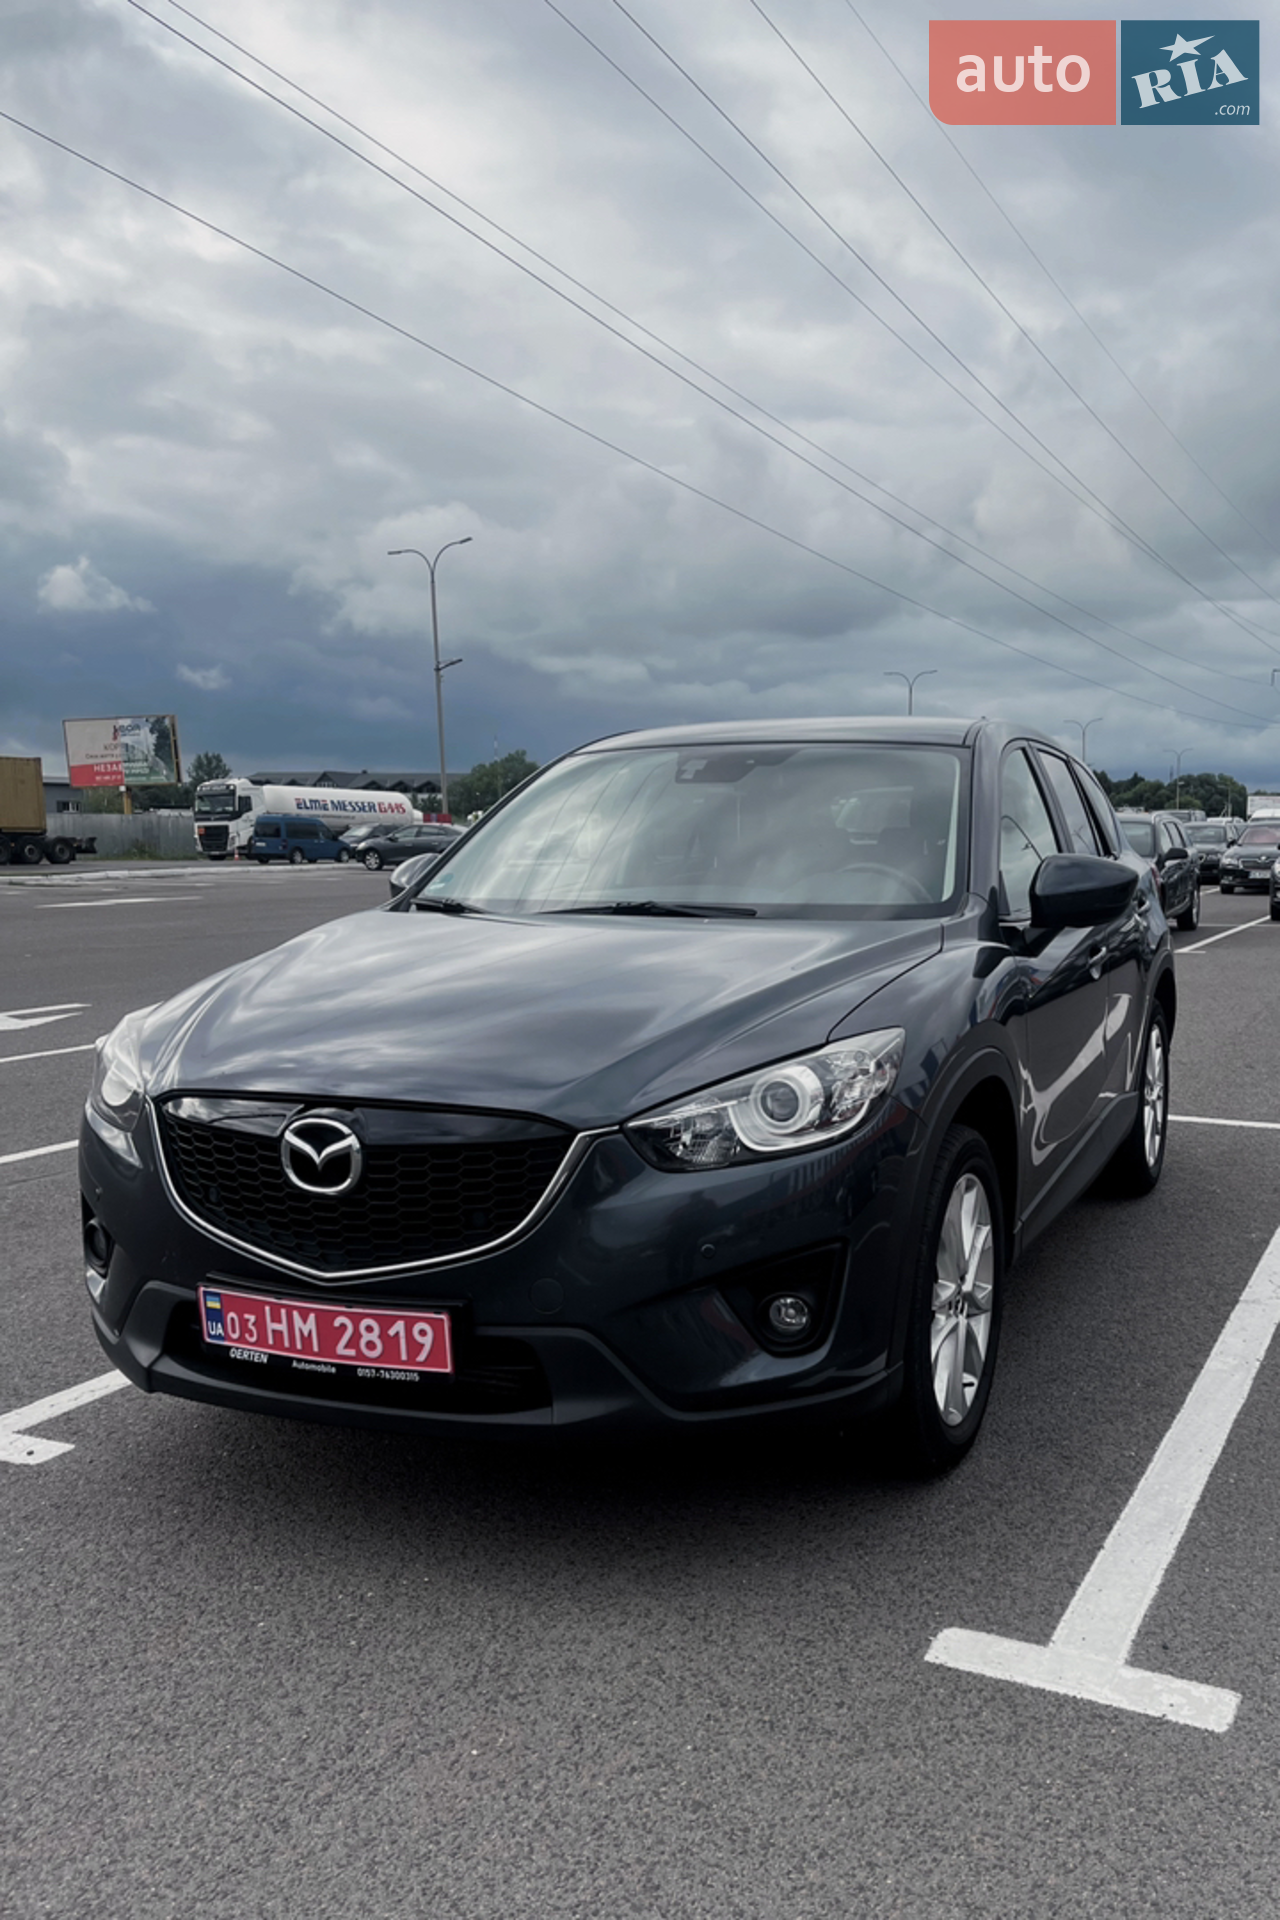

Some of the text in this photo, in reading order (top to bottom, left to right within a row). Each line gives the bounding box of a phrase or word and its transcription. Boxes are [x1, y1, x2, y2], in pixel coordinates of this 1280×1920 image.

[331, 799, 377, 813] MESSER
[208, 1320, 225, 1337] UA
[226, 1305, 434, 1362] 03 HM 2819
[292, 1359, 336, 1374] Automobile
